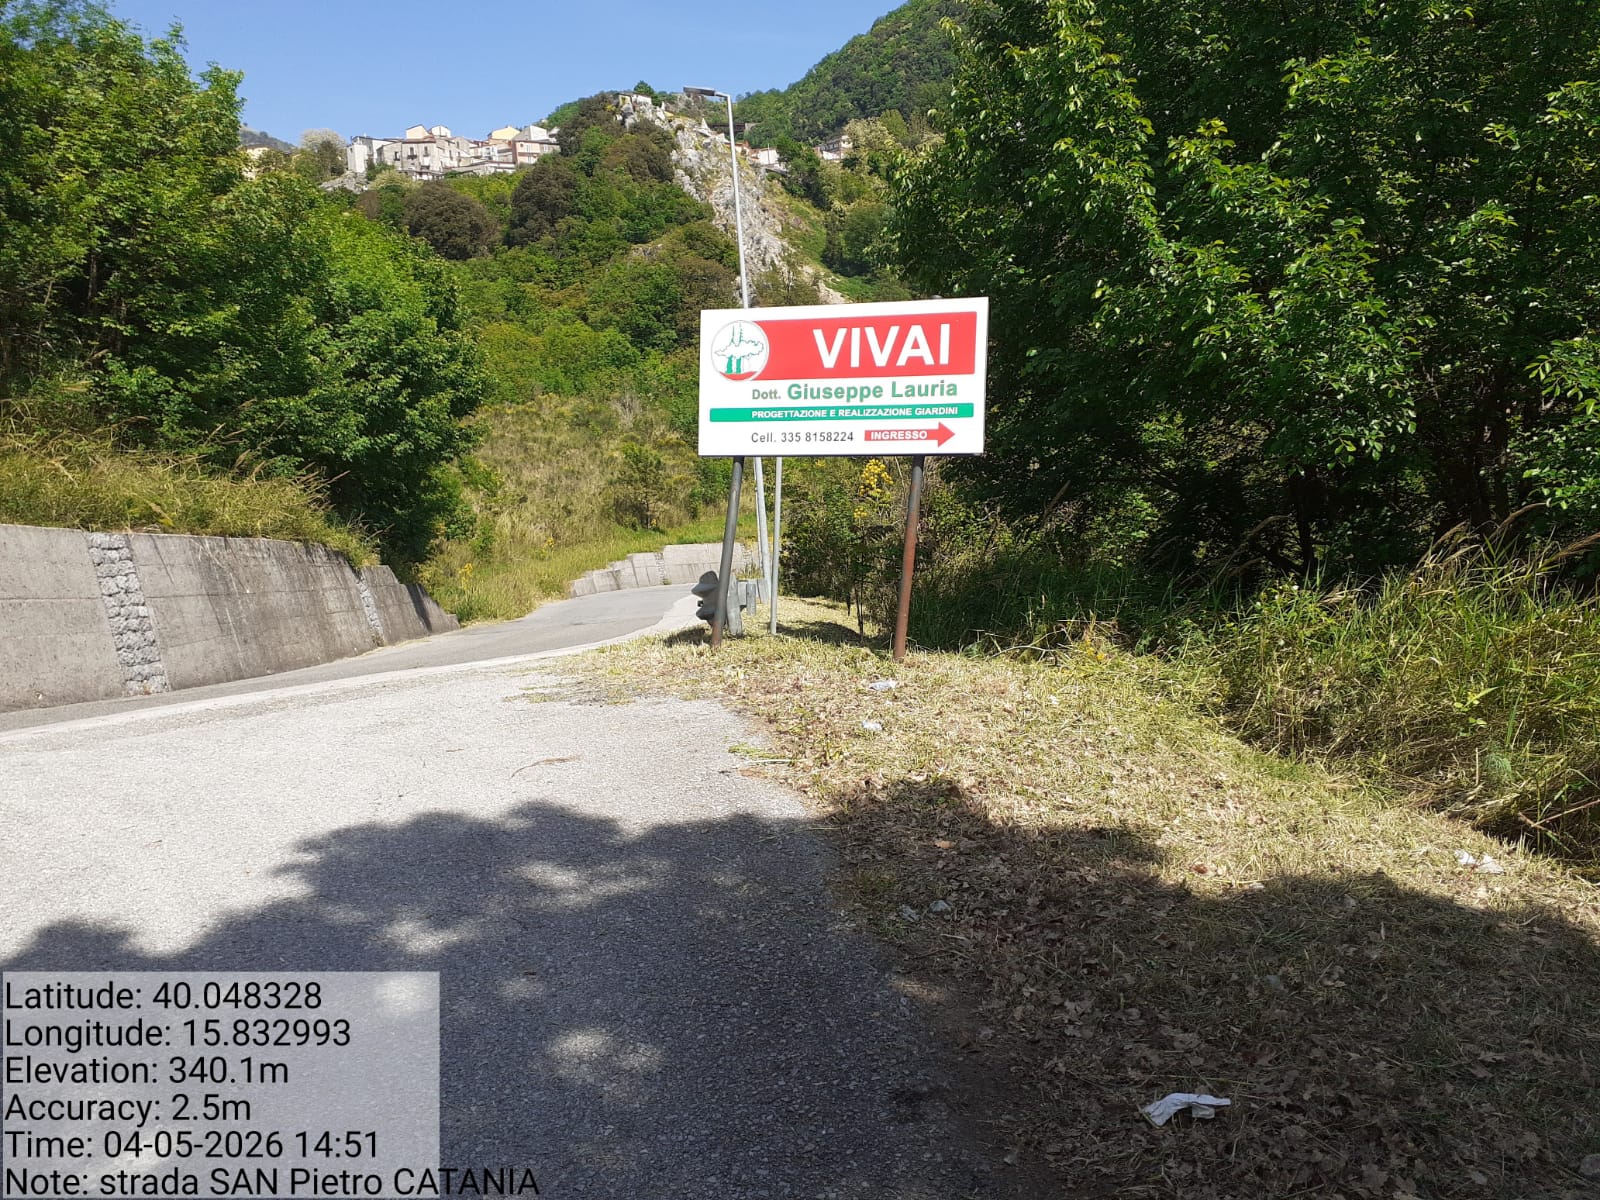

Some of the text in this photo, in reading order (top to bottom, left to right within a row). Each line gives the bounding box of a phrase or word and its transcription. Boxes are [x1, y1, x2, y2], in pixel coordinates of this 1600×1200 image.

[813, 323, 951, 369] VIVAI
[752, 380, 957, 402] Dott. Giuseppe Lauria
[752, 409, 827, 418] PROGETTAZIONE
[838, 408, 912, 417] REALIZZAZIONE
[915, 407, 958, 415] GIARDINI
[751, 431, 854, 443] Cell. 335 8158224
[871, 431, 927, 440] INGRESSO
